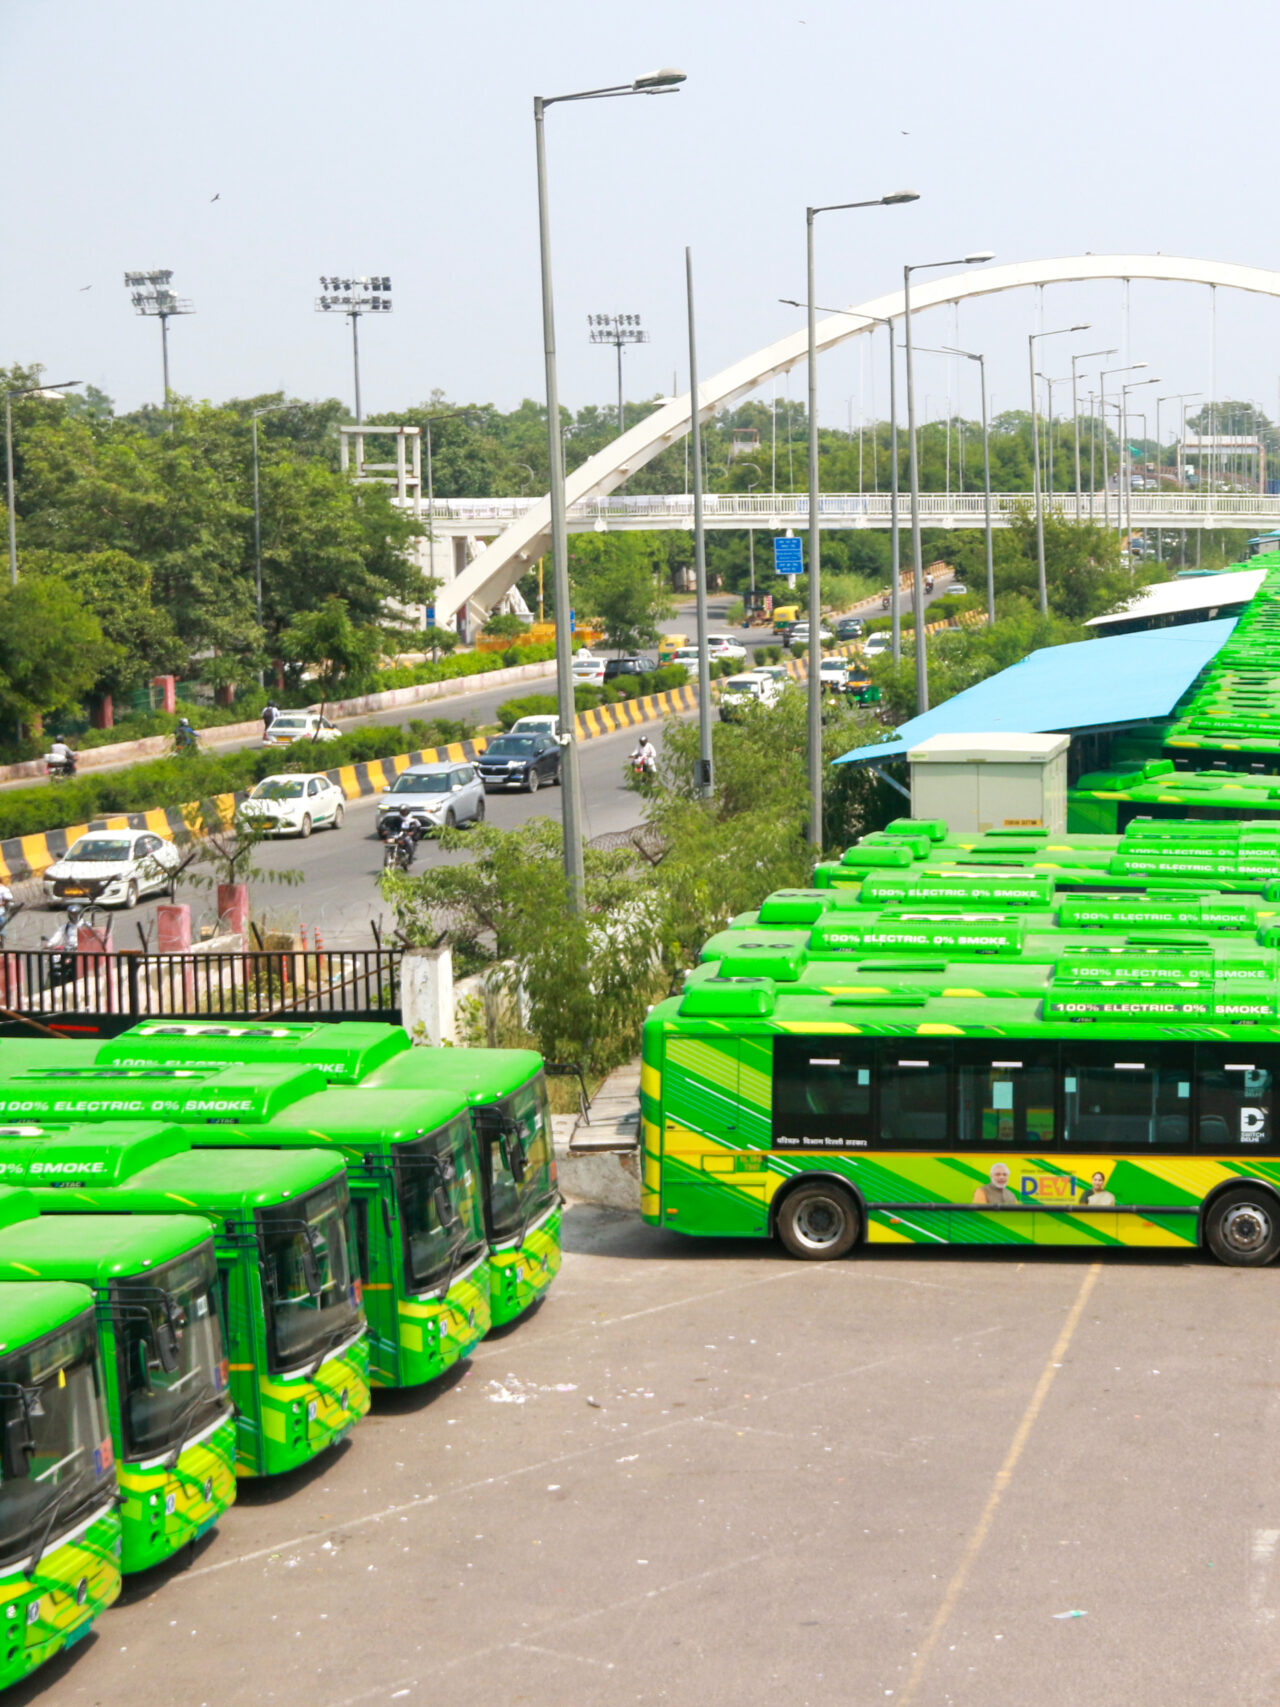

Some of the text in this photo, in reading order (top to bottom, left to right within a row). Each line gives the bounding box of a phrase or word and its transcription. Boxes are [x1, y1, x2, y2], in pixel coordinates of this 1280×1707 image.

[1159, 863, 1215, 871] ELECTRIC.
[908, 889, 969, 897] ELECTRIC.
[972, 889, 991, 897] 0%
[994, 890, 1041, 898] SMOKE.
[1074, 912, 1110, 920] 100%
[1113, 913, 1175, 921] ELECTRIC.
[822, 934, 1010, 946] 100% ELECTRIC. 0% SMOKE.
[1071, 968, 1270, 978] 100% ELECTRIC. 0% SMOKE.
[1056, 1003, 1274, 1014] 100% ELECTRIC. 0% SMOKE.
[53, 1101, 144, 1111] ELECTRIC.
[151, 1100, 180, 1112] 0%
[184, 1100, 256, 1111] SMOKE.
[30, 1162, 108, 1174] SMOKE.
